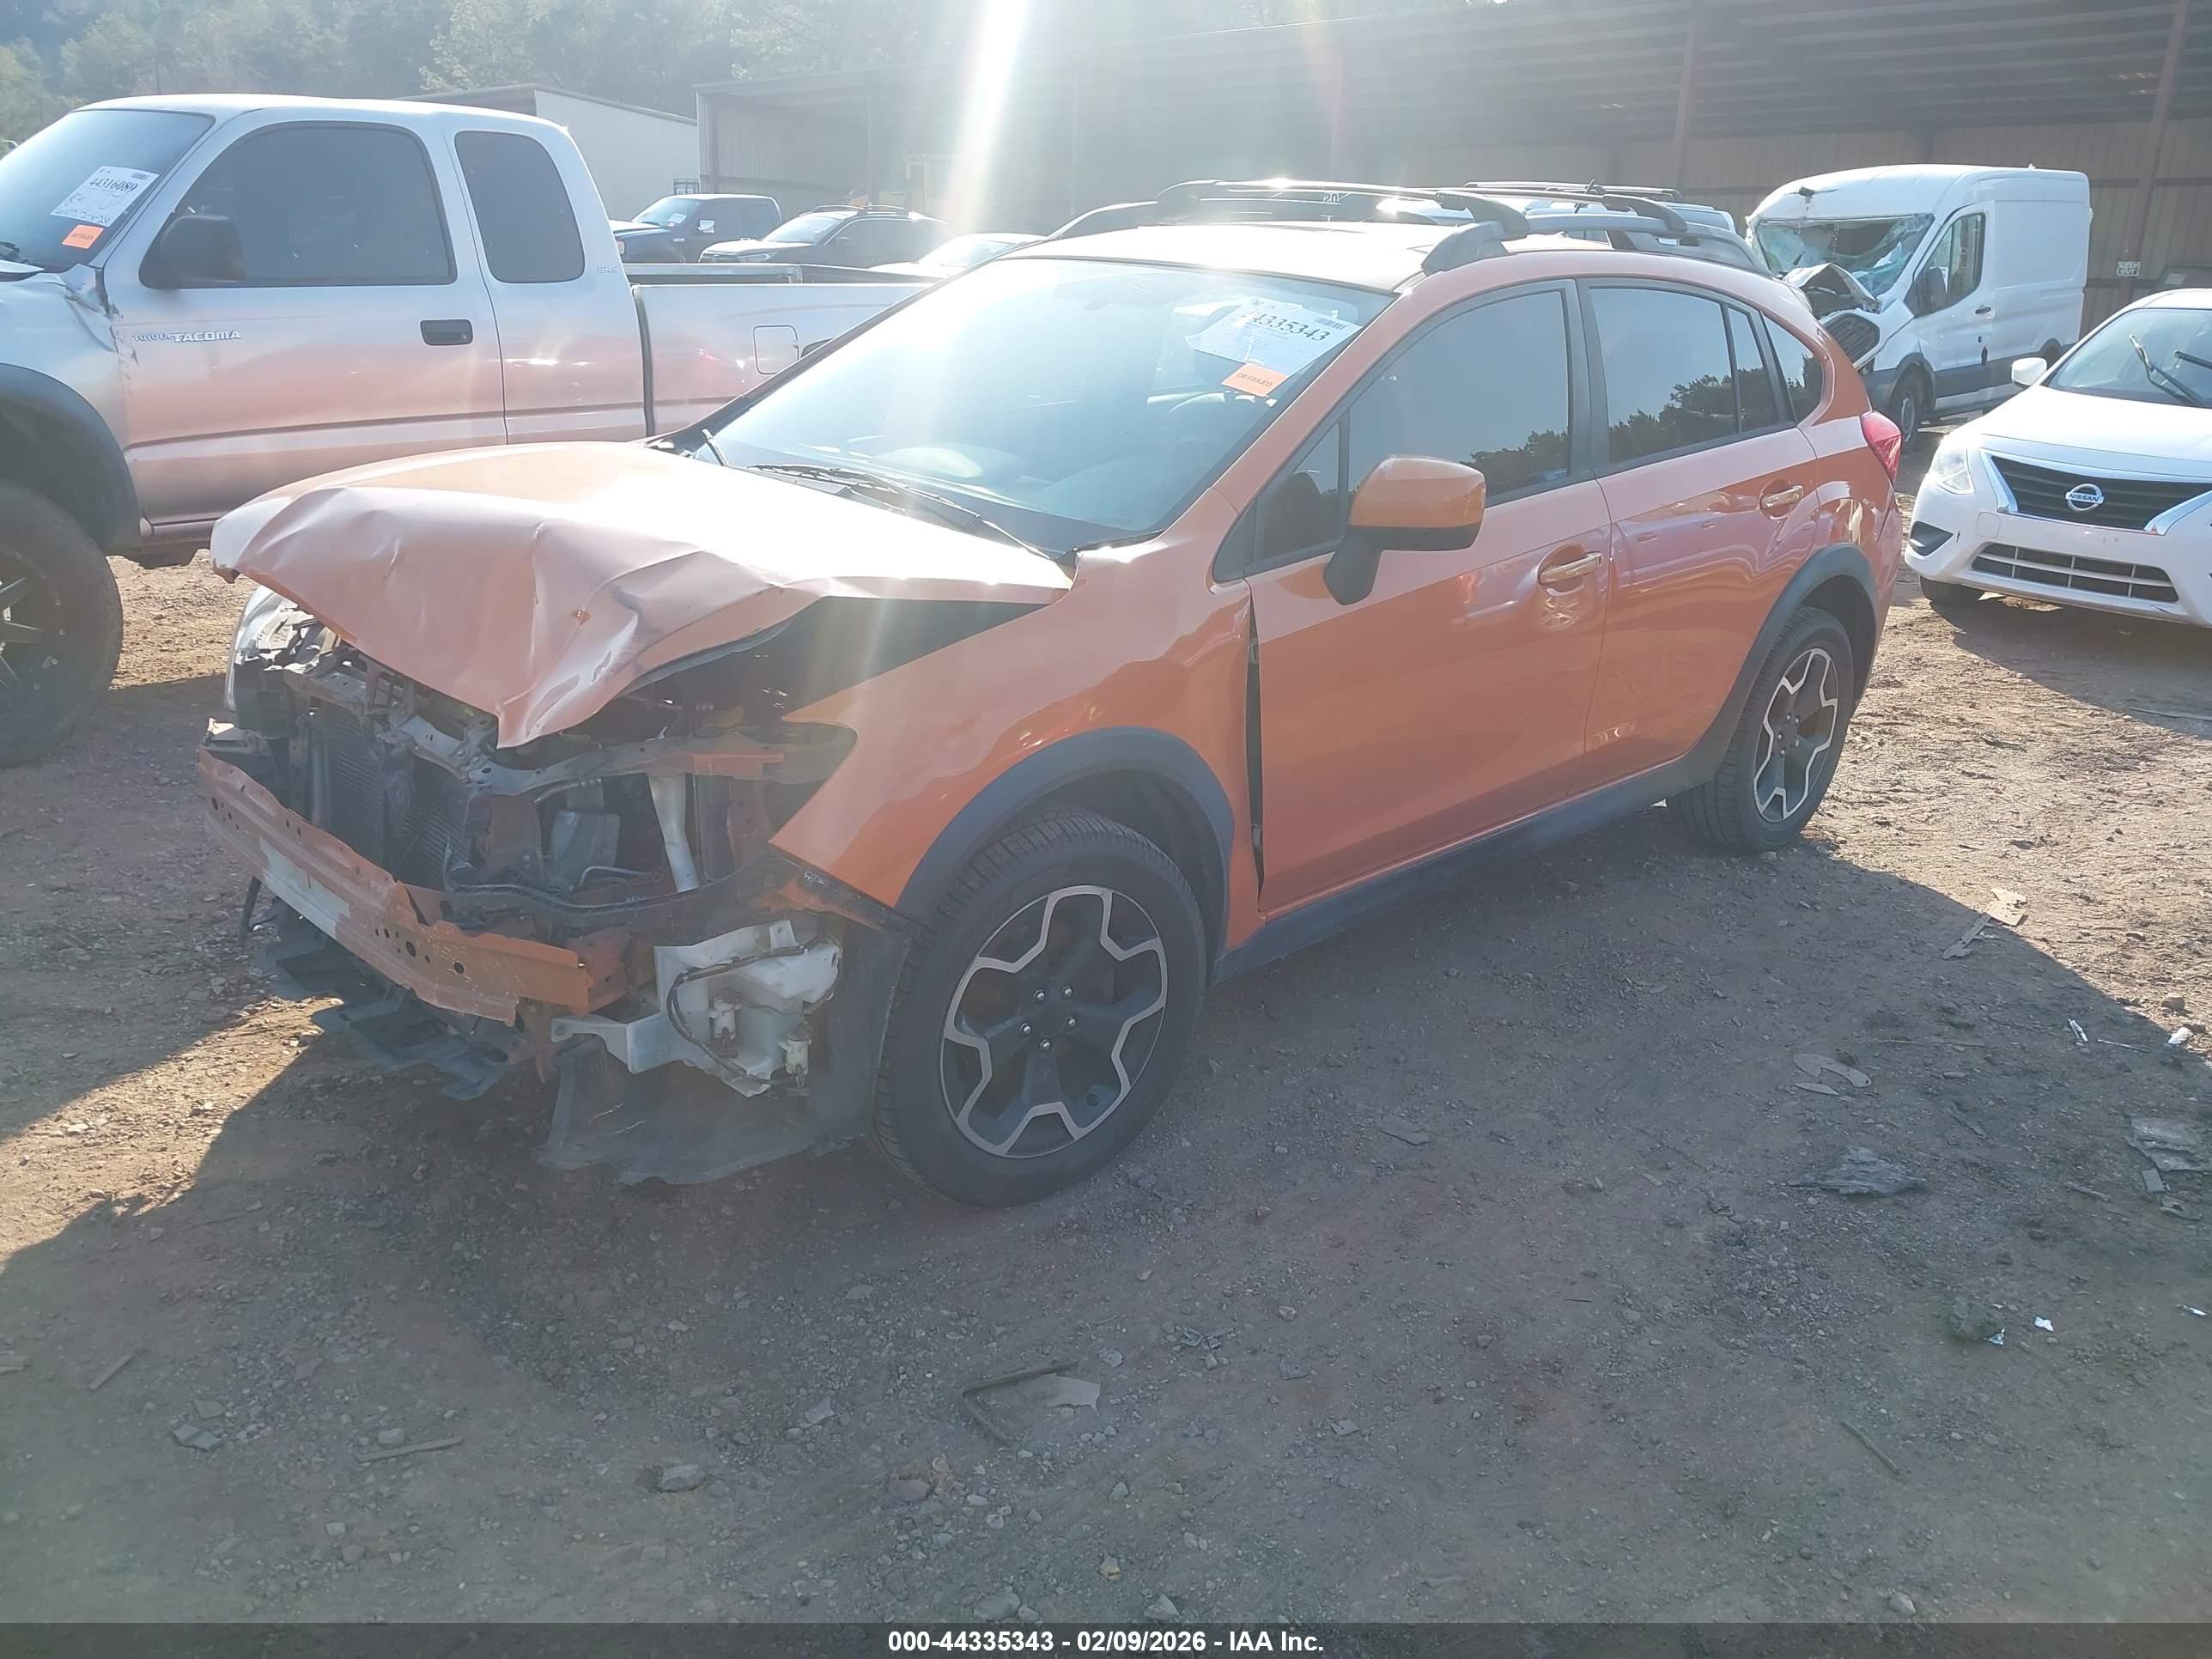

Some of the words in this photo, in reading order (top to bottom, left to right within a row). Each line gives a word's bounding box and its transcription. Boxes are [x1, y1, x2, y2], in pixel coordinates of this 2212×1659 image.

[89, 178, 138, 192] 44316089
[172, 330, 241, 343] TACOMA
[1237, 373, 1273, 386] DETAILED
[2069, 494, 2100, 502] NISSAN
